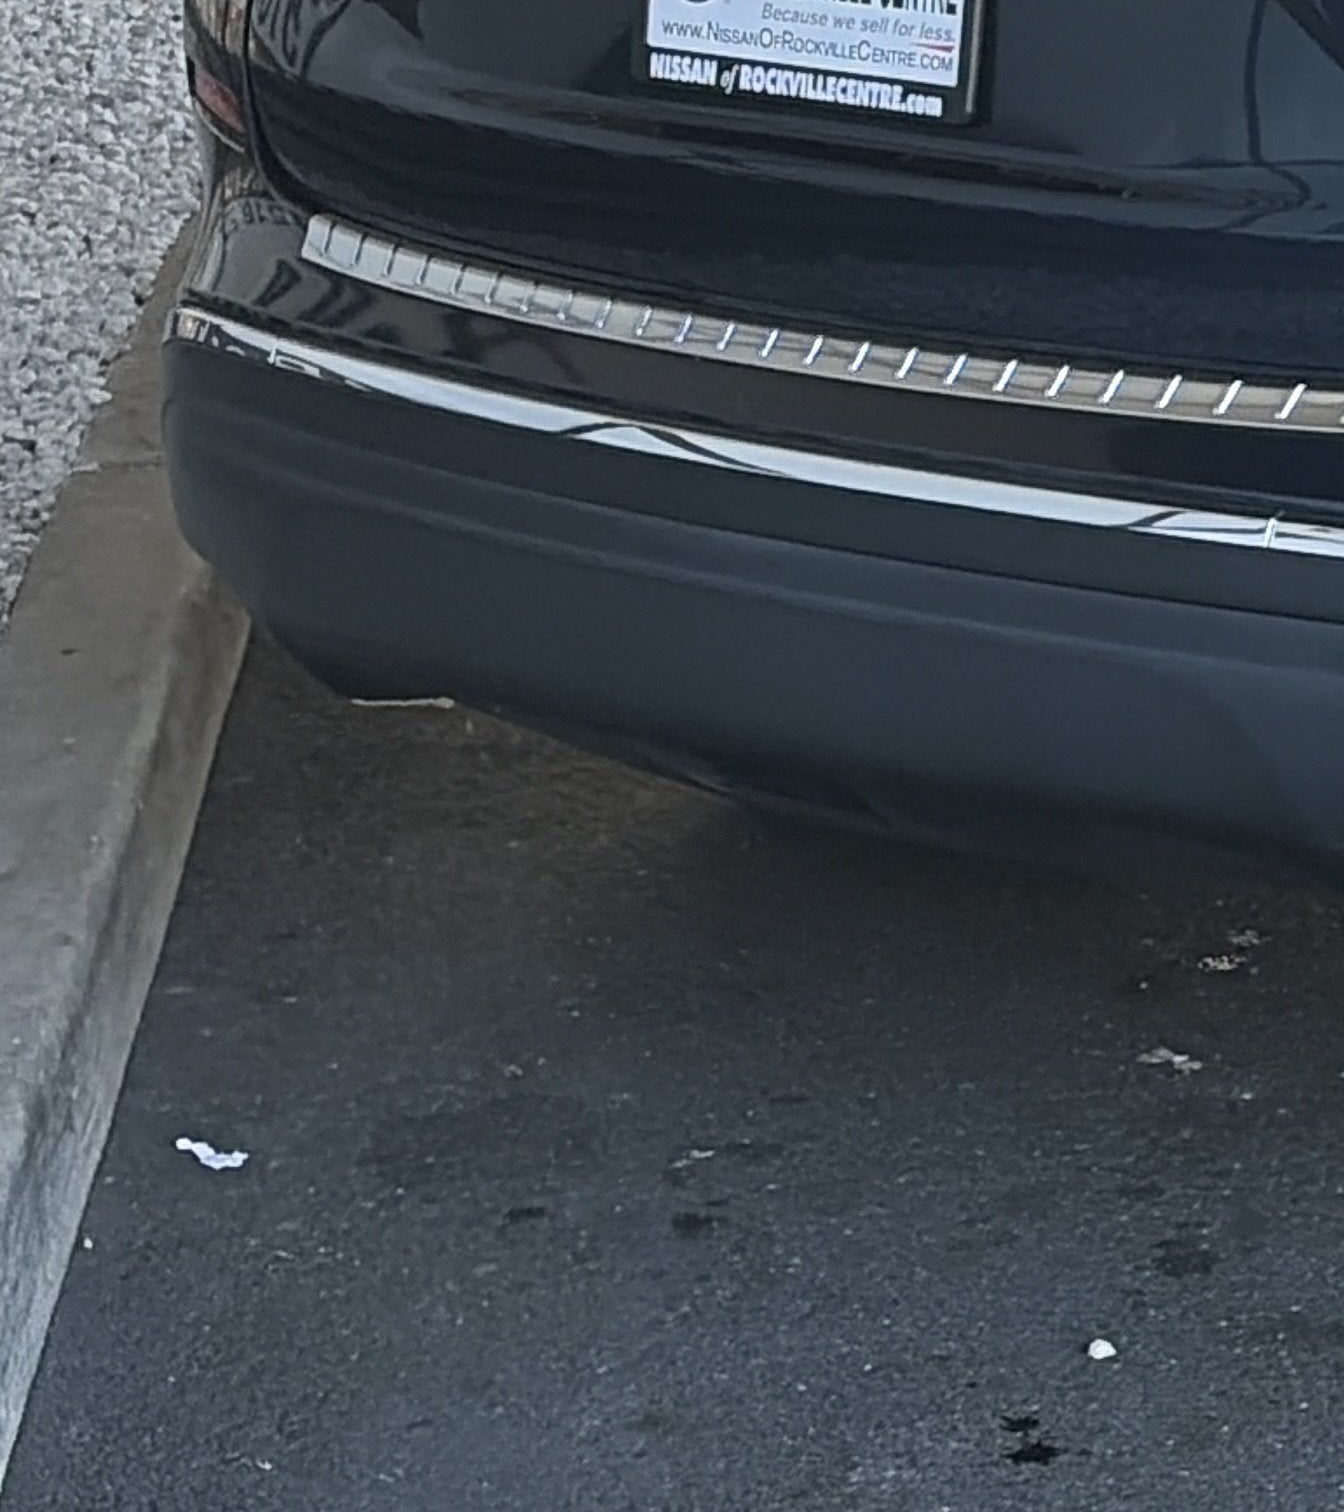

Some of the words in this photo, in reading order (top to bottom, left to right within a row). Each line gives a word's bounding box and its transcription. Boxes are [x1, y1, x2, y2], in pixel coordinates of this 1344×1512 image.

[761, 2, 828, 27] Because
[833, 14, 855, 30] we
[859, 17, 890, 33] sell
[892, 19, 917, 37] for
[650, 52, 718, 86] NISSAN
[720, 64, 740, 95] of
[739, 64, 943, 118] ROCKVILLECENTRE.com
